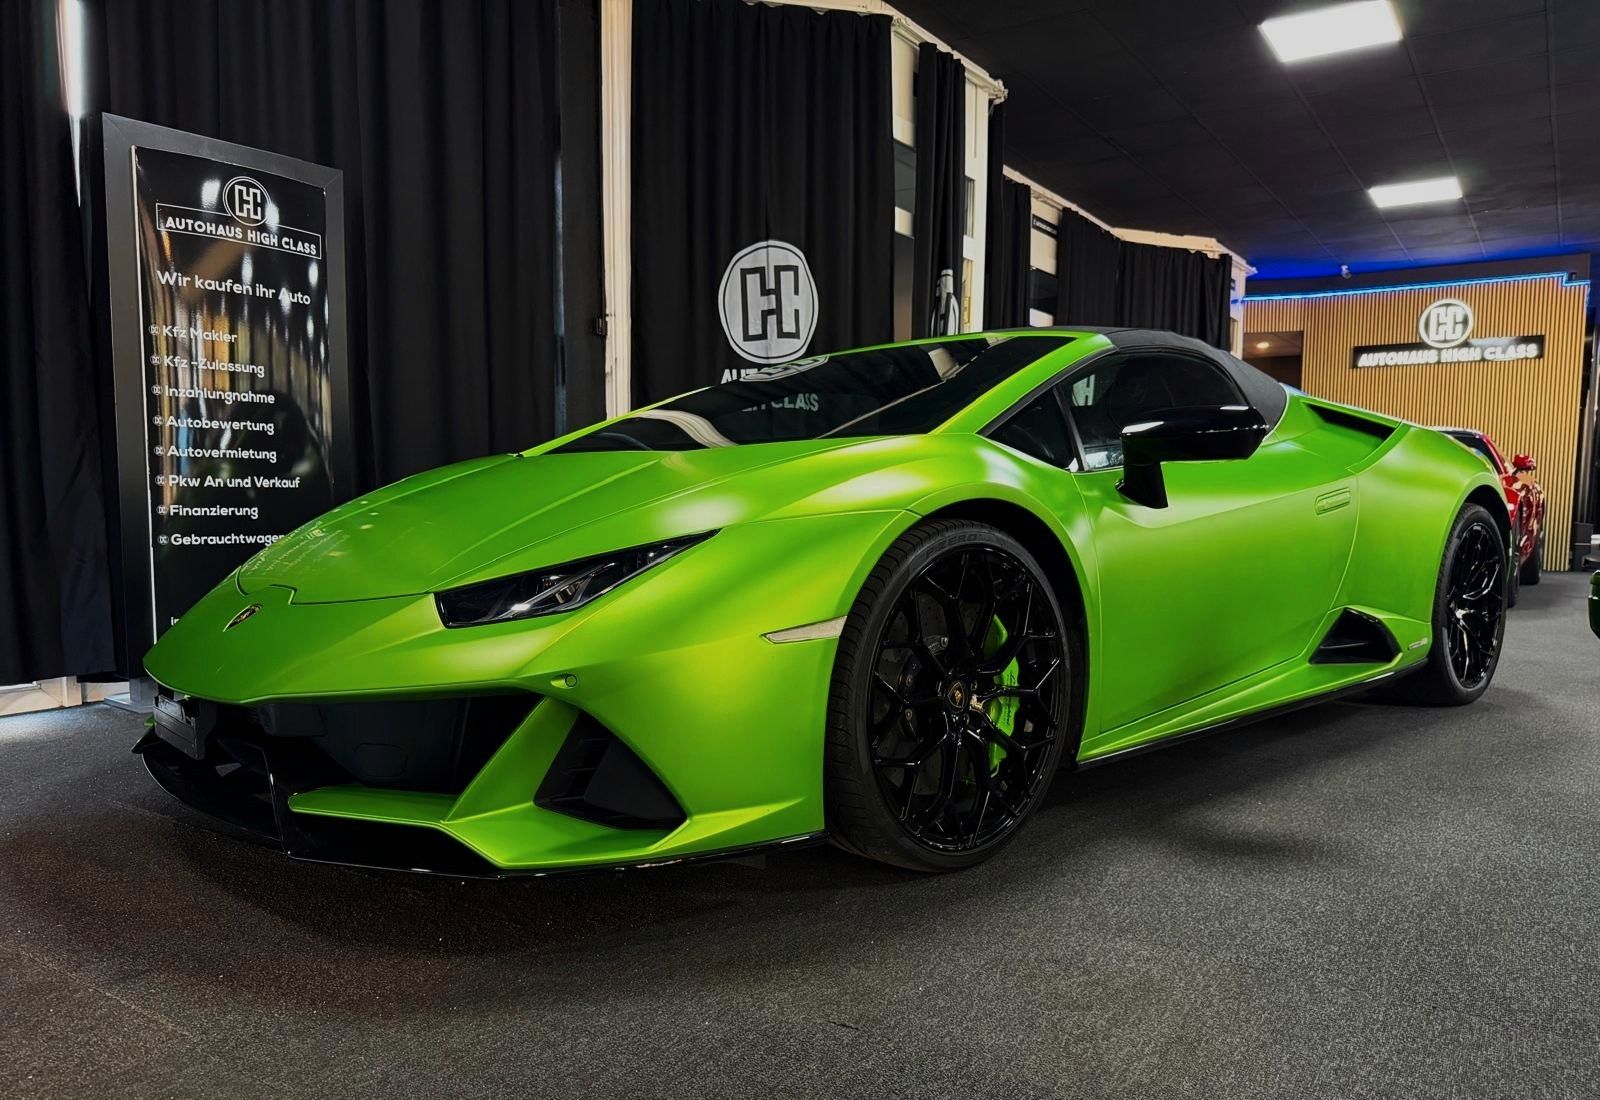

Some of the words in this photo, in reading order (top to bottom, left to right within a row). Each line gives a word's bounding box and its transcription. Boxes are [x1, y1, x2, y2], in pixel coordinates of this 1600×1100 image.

[166, 216, 242, 239] AUTOHAUS
[247, 230, 278, 247] HIGH
[281, 237, 317, 255] CLASS
[156, 270, 191, 287] Wir
[195, 274, 253, 295] kaufen
[256, 284, 276, 299] ihr
[278, 287, 311, 305] Auto
[162, 325, 186, 338] Kfz
[190, 327, 238, 343] Makler
[164, 355, 188, 368] Kfz
[1357, 350, 1438, 367] AUTOHAUS
[1441, 347, 1480, 363] HIGH
[1483, 343, 1539, 361] CLASS
[165, 384, 276, 404] Inzahlungnahme
[166, 416, 275, 435] Autobewertung
[167, 445, 277, 464] Autovermietung
[168, 475, 200, 488] Pkw
[204, 475, 224, 488] An
[226, 476, 252, 488] und
[254, 476, 300, 488] Verkauf
[170, 505, 258, 519] Finanzierung
